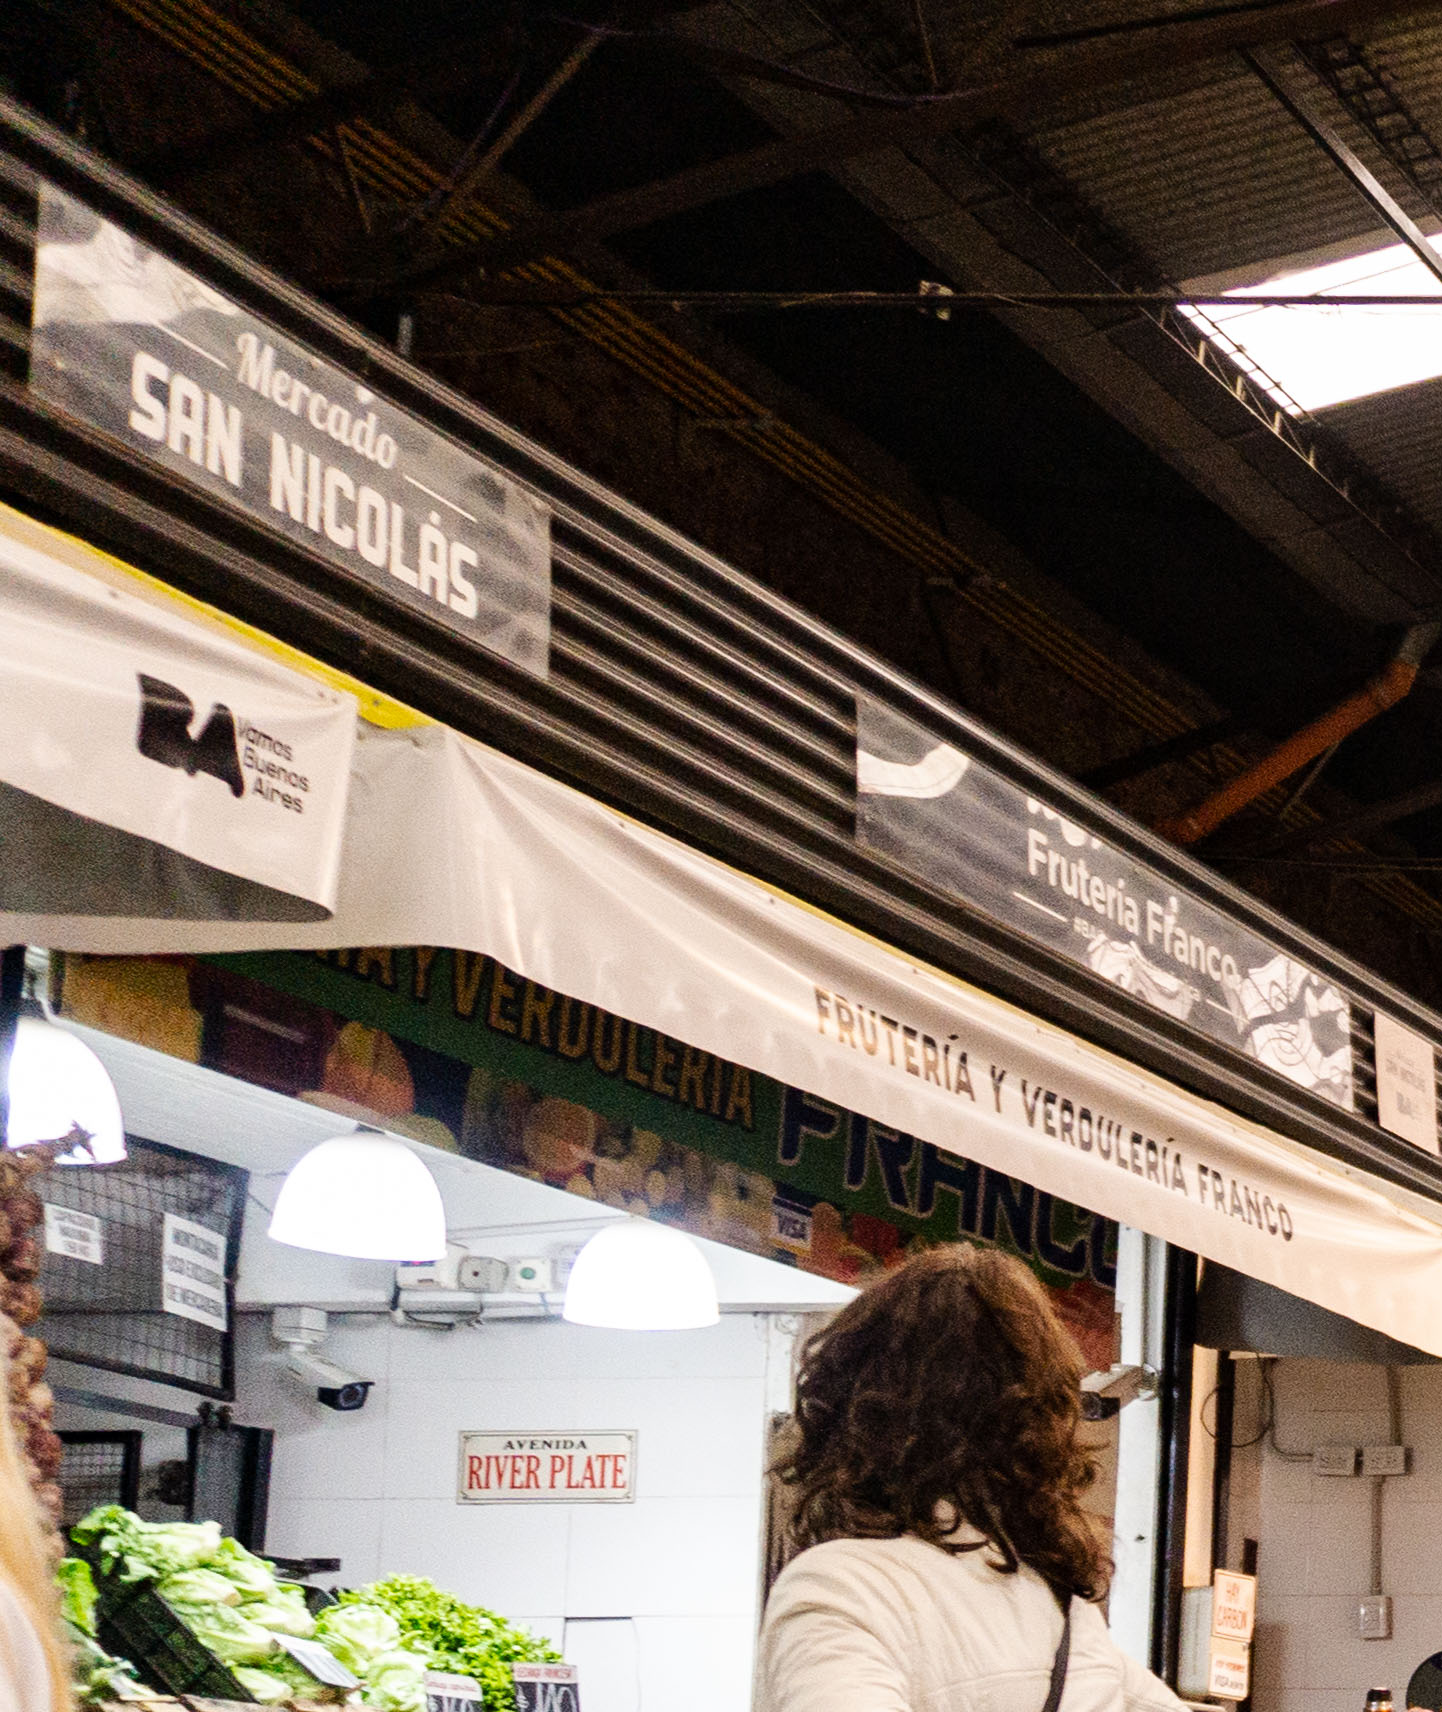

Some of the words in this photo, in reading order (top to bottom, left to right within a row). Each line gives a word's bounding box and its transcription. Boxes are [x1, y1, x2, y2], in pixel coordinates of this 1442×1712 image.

[237, 332, 400, 470] Mercado
[128, 350, 243, 488] SAN
[270, 432, 478, 620] NICOLÁS
[238, 717, 293, 762] Vamos
[243, 746, 310, 793] Buenos
[252, 776, 304, 815] Aires
[1147, 896, 1242, 990] Franco
[813, 985, 977, 1102] FRUTERÍA
[990, 1064, 1008, 1113] Y
[1020, 1078, 1189, 1197] VERDULERÍA
[1197, 1163, 1294, 1242] FRANCO
[504, 1440, 588, 1450] AVENIDA
[468, 1455, 541, 1489] RIVER
[550, 1455, 627, 1489] PLATE
